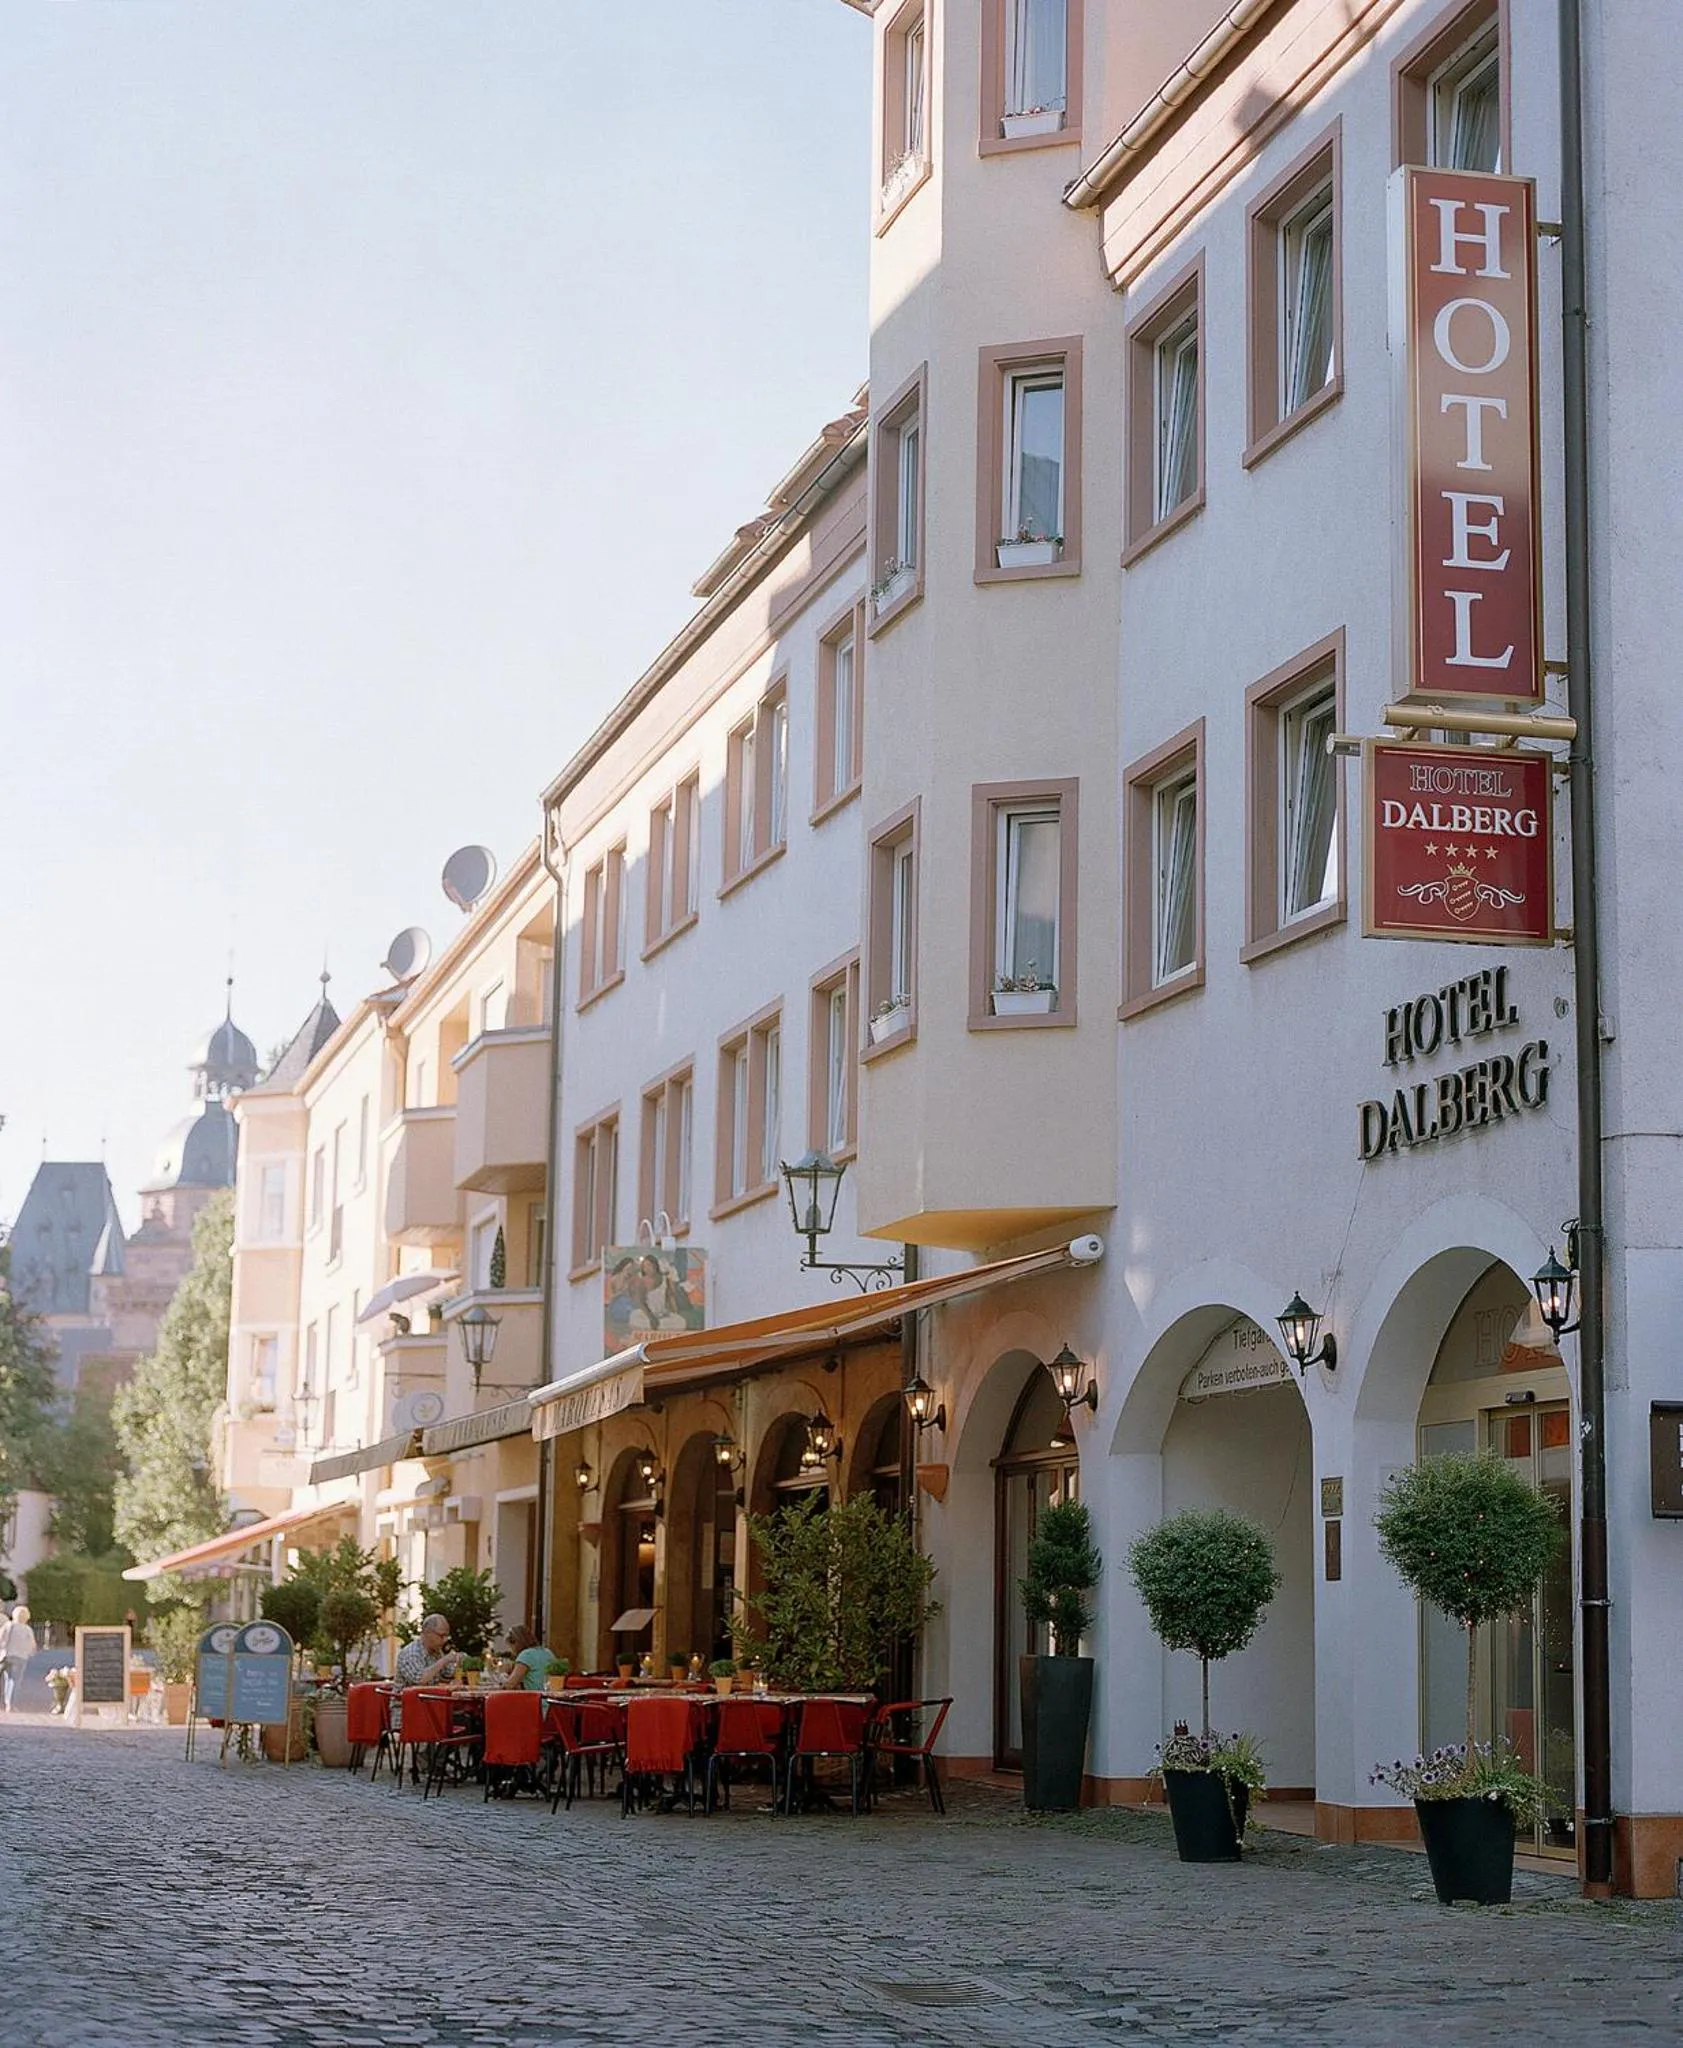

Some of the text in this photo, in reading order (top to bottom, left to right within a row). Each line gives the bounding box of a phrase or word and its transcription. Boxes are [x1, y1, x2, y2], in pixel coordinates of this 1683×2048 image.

[1428, 197, 1515, 669] HOTEL
[1408, 763, 1513, 798] HOTEL
[1381, 799, 1538, 838] DALBERG
[1381, 965, 1519, 1067] HOTEL
[1356, 1038, 1550, 1160] DALBERG
[1197, 1370, 1224, 1390] Parken
